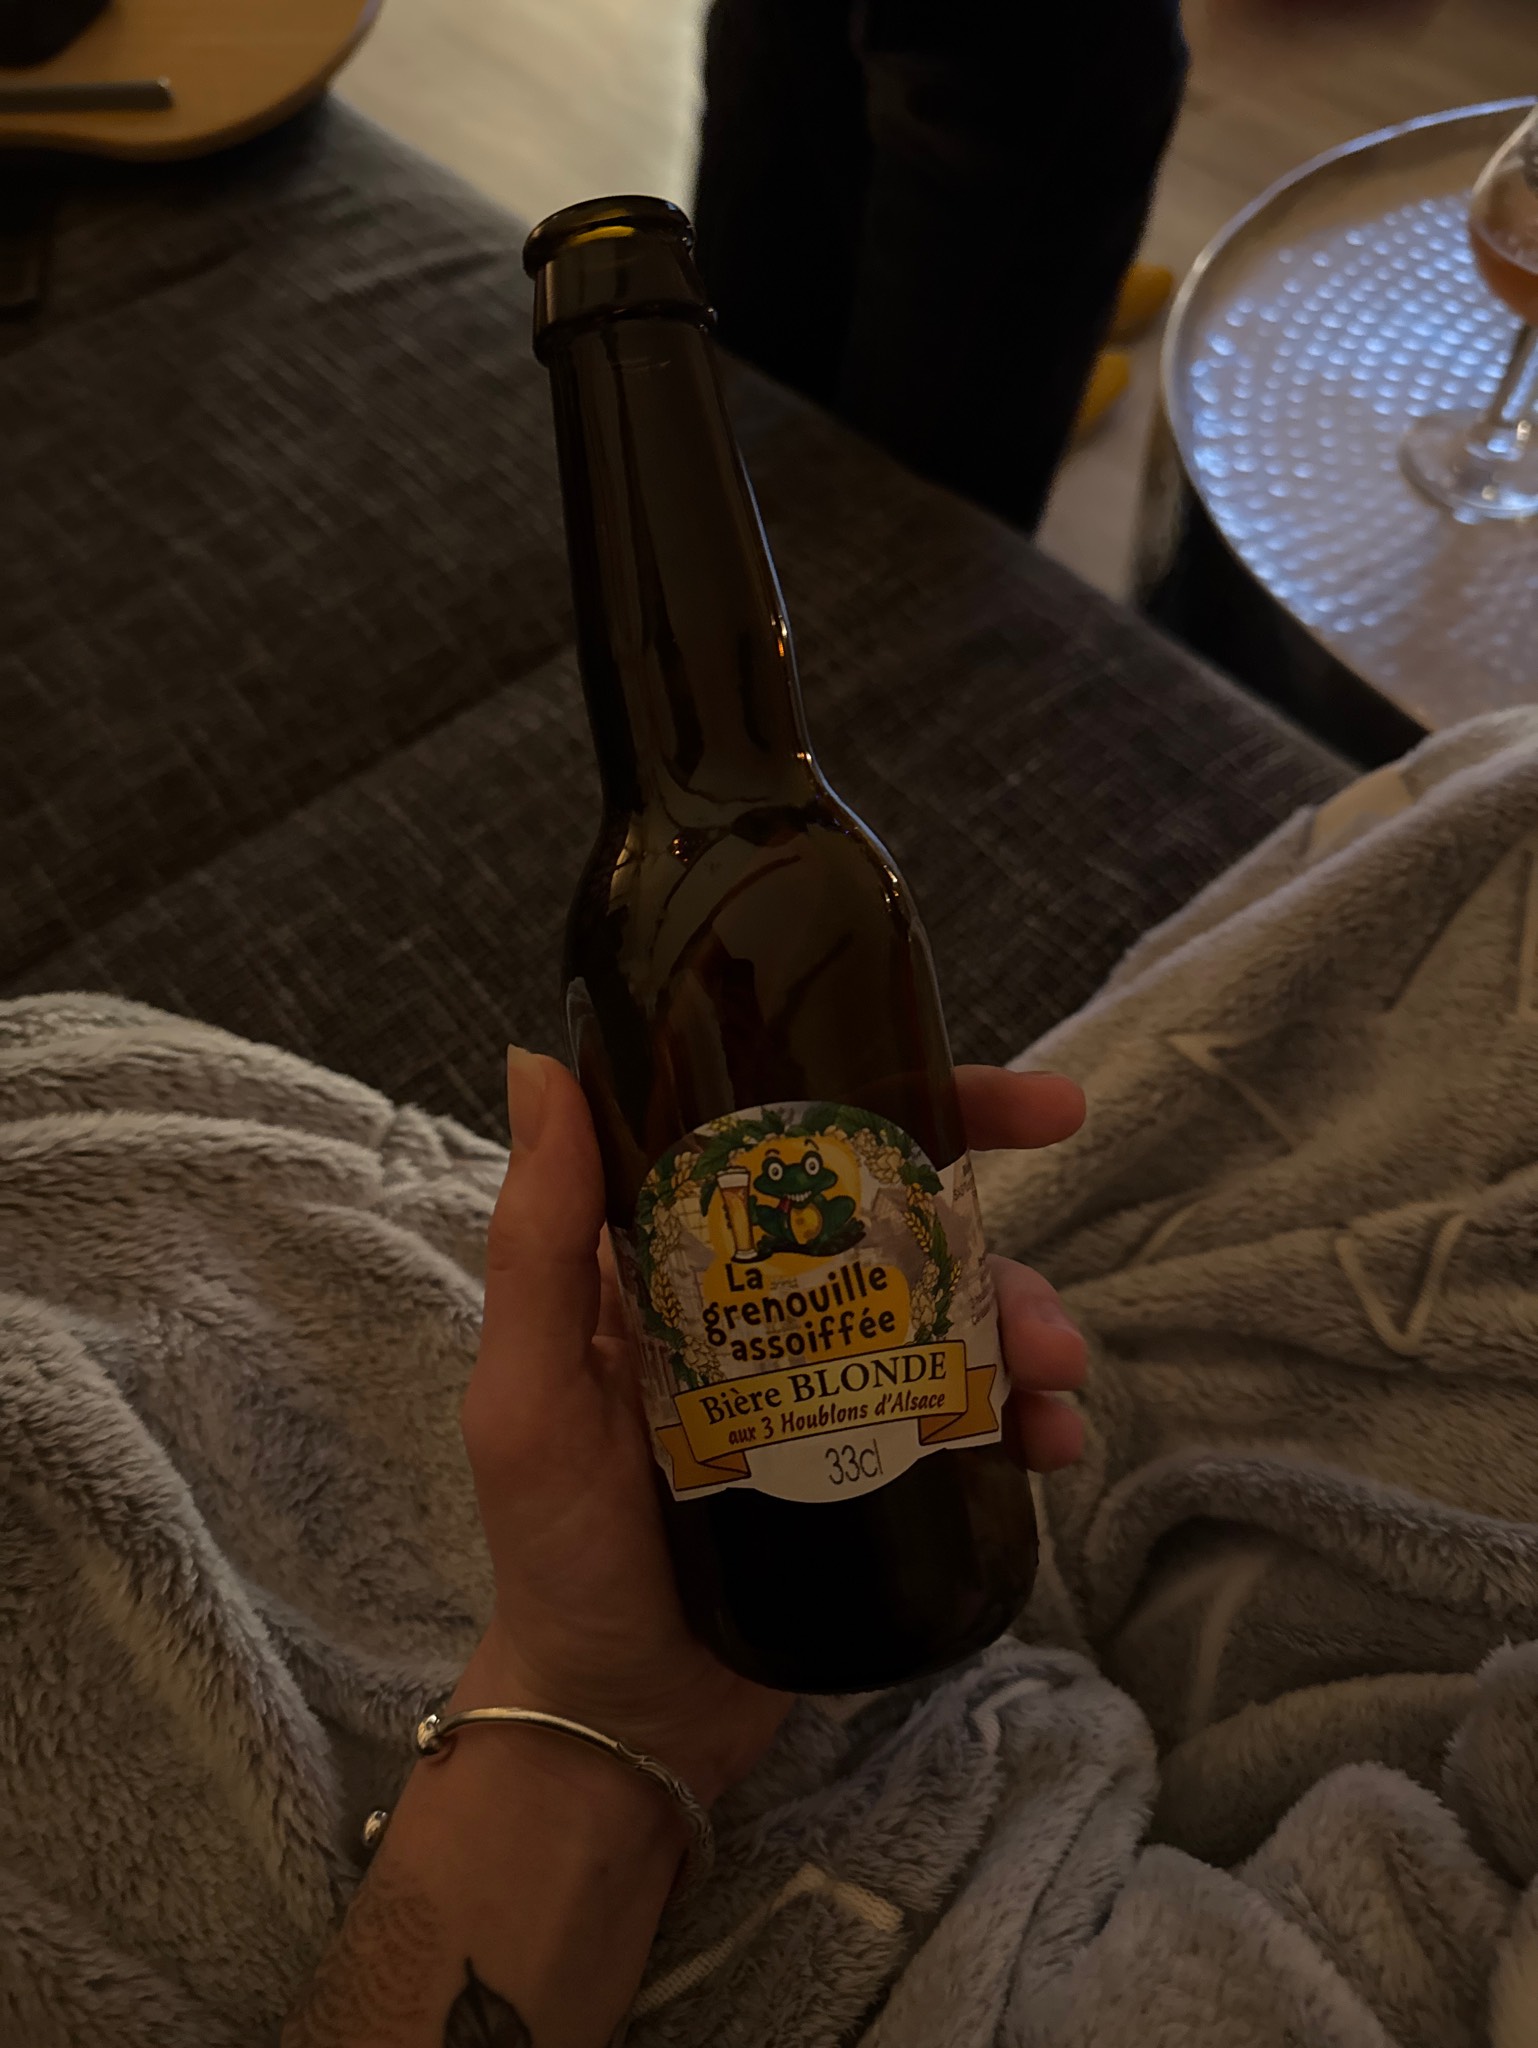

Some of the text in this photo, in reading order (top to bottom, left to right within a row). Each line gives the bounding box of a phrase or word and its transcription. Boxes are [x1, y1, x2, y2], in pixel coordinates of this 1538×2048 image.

[702, 1261, 888, 1347] grenouille
[725, 1263, 763, 1292] La
[730, 1307, 896, 1362] assoiffée
[699, 1351, 947, 1425] Bière BLONDE
[728, 1390, 945, 1445] aux 3 Houblons d'Alsace
[824, 1438, 884, 1485] 33cl
